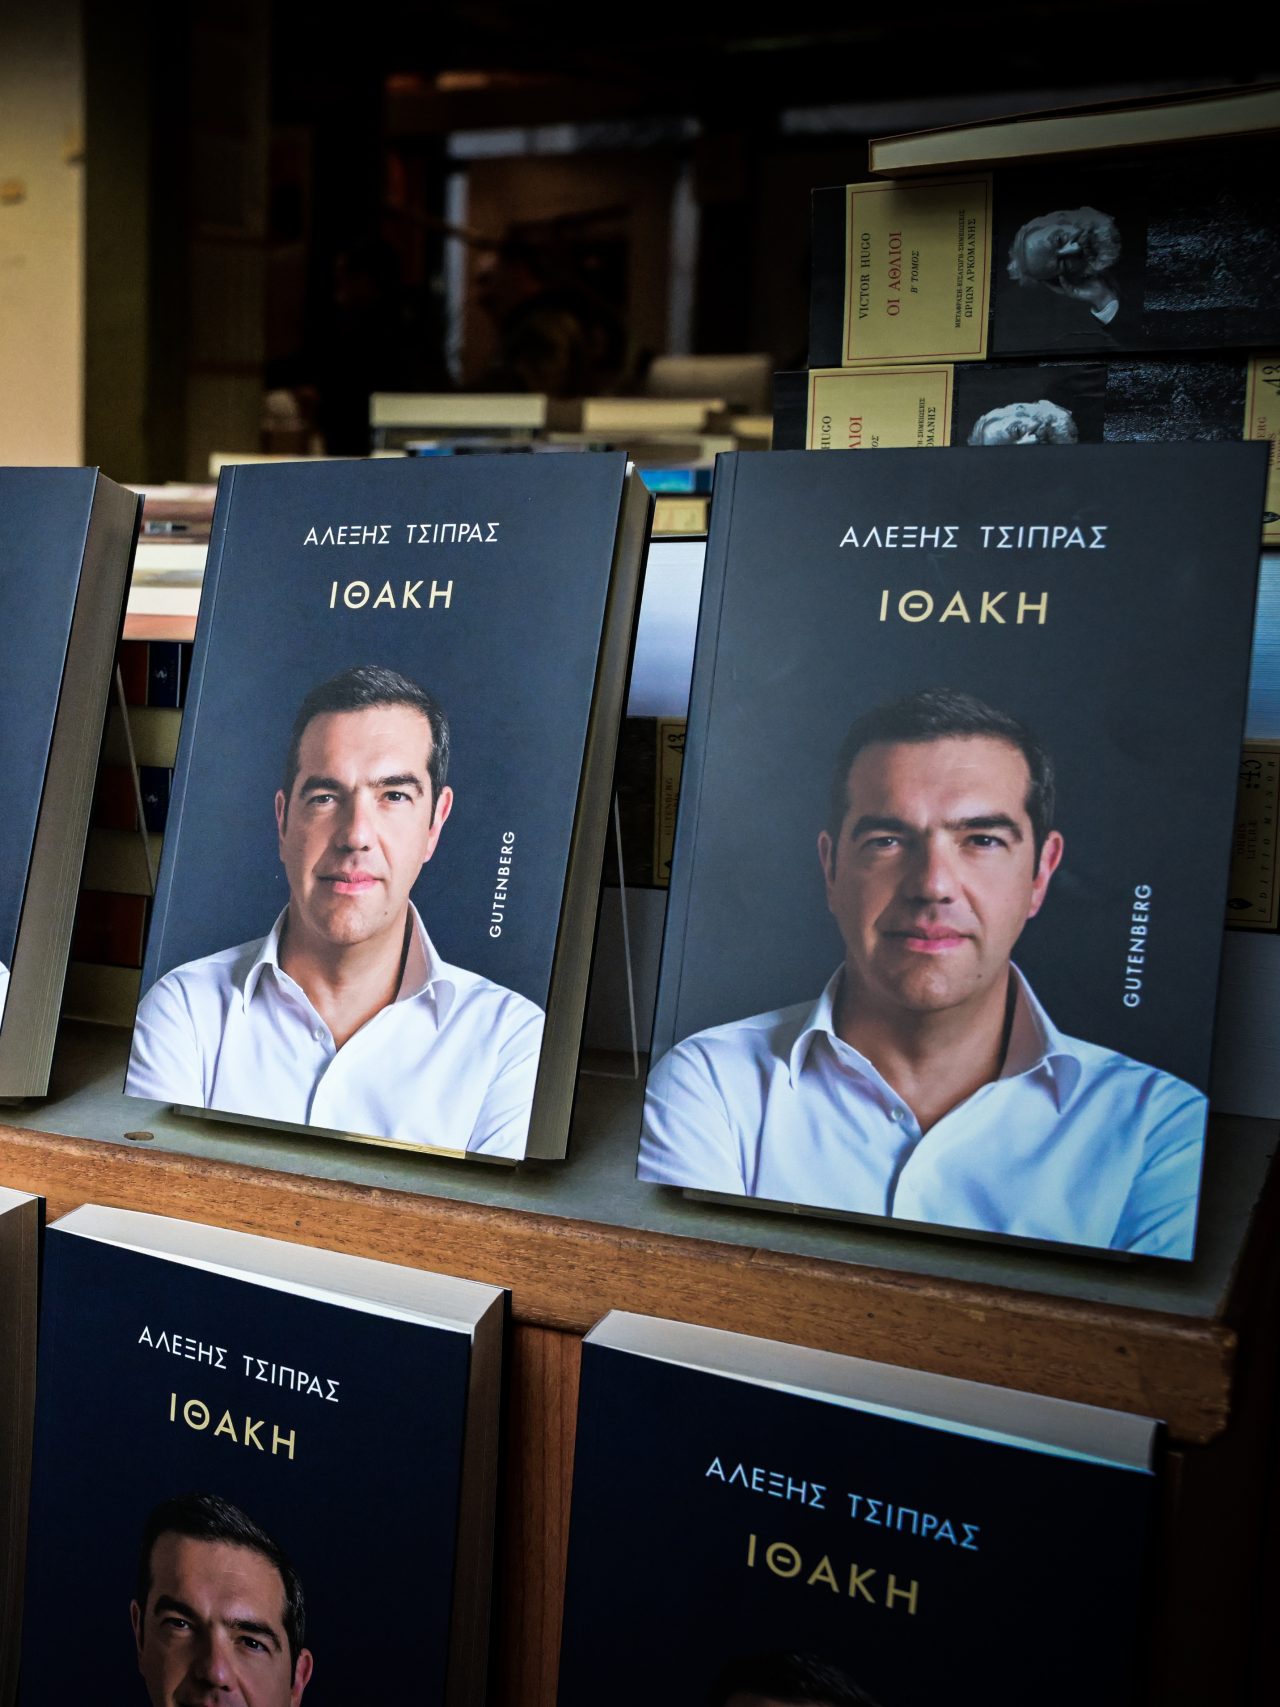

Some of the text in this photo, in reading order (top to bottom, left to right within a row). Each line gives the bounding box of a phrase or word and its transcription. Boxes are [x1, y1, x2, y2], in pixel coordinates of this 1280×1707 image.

[858, 232, 872, 320] VICTOR HUGO
[886, 231, 903, 317] ΟΙ ΑΘΛΙΟΙ
[910, 250, 920, 282] ΤΟΜΟΣ
[965, 217, 977, 319] ΩΡΙΩΝ ΑΡΚΟΜΑΝΗΣ
[848, 416, 863, 450] ΛΙΟΙ
[303, 522, 500, 546] ΑΛΕΞΗΣ ΤΣΙΠΡΑΣ
[839, 525, 1108, 549] ΑΛΕΞΗΣ ΤΣΙΠΡΑΣ
[329, 580, 454, 609] ΙΘΑΚΗ
[879, 589, 1048, 625] ΙΘΑΚΗ
[489, 831, 515, 938] GUTENBERG
[1122, 884, 1152, 1008] GUTENBERG
[138, 1325, 340, 1403] ΑΛΕΞΗΣ ΤΣΙΠΡΑΣ
[169, 1392, 296, 1460] ΙΘΑΚΗ
[704, 1456, 980, 1551] ΑΛΕΞΗΣ ΤΣΙΠΡΑΣ
[747, 1533, 918, 1615] ΙΘΑΚΗ
